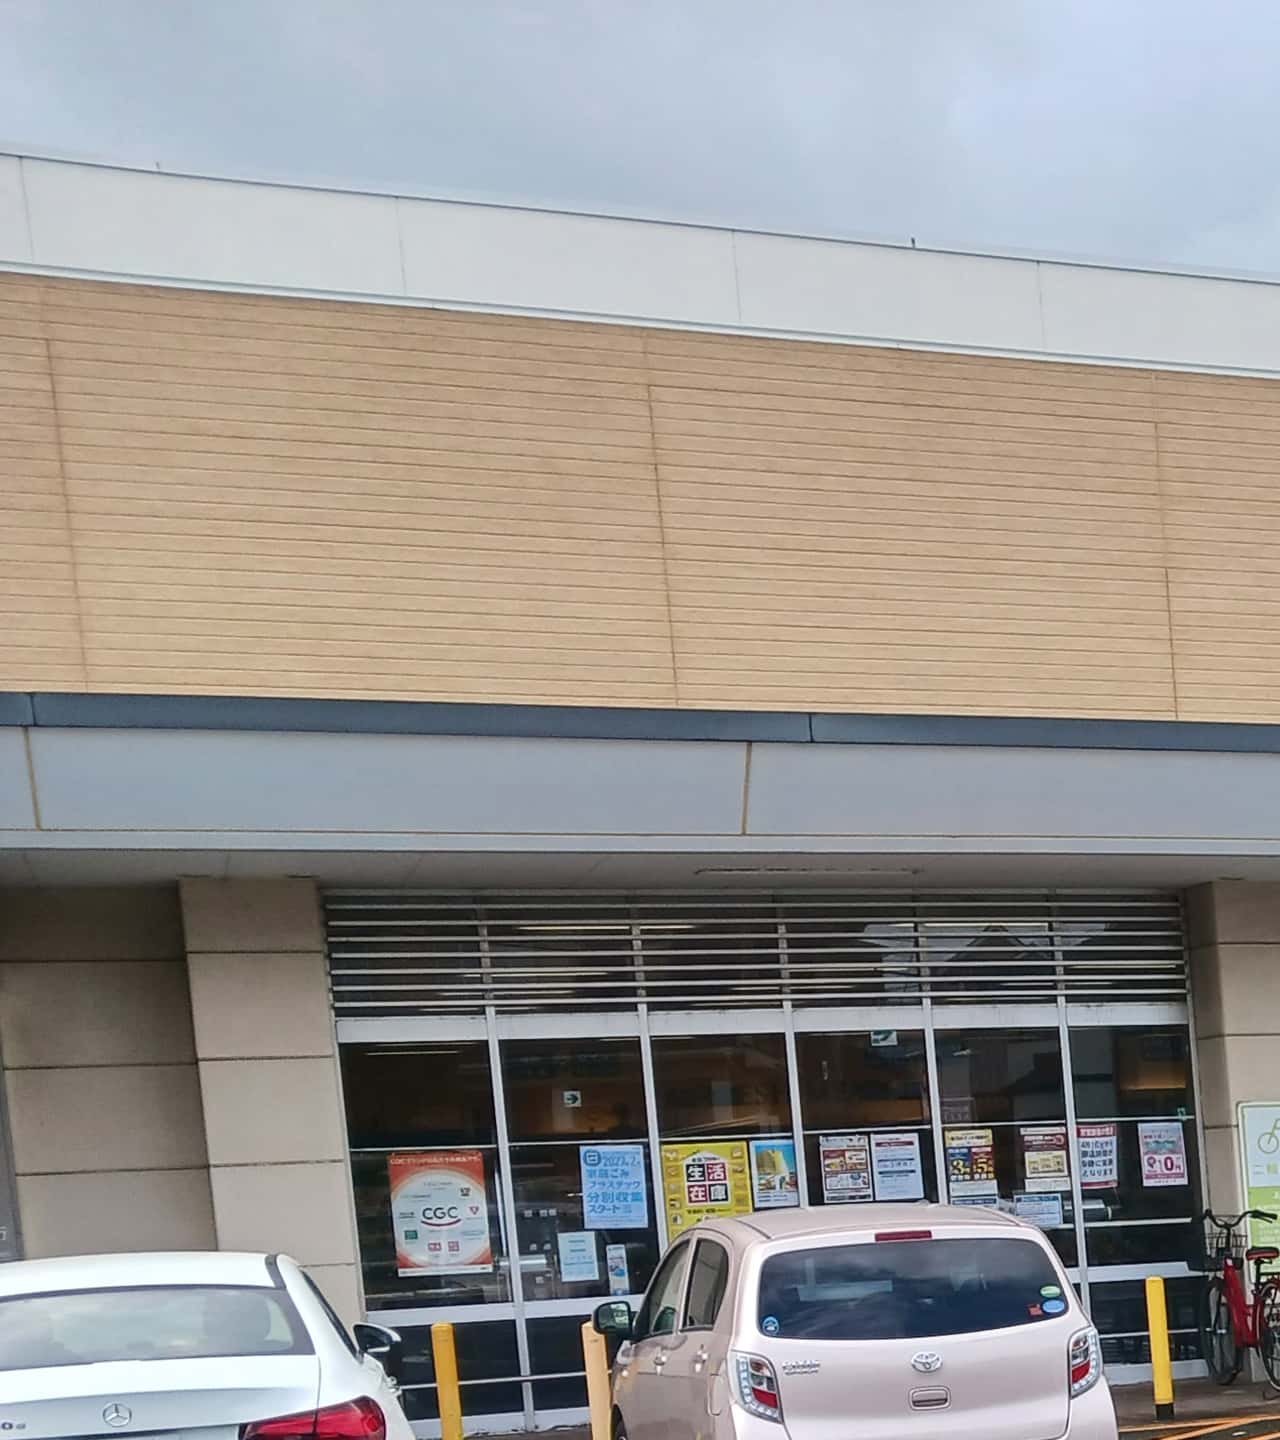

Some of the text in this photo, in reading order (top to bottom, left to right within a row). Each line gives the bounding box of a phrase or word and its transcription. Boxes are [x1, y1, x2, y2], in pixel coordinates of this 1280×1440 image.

[688, 1164, 724, 1181] 生活
[587, 1191, 643, 1203] 分別収集
[690, 1184, 727, 1201] 在庫
[422, 1206, 459, 1220] CGC
